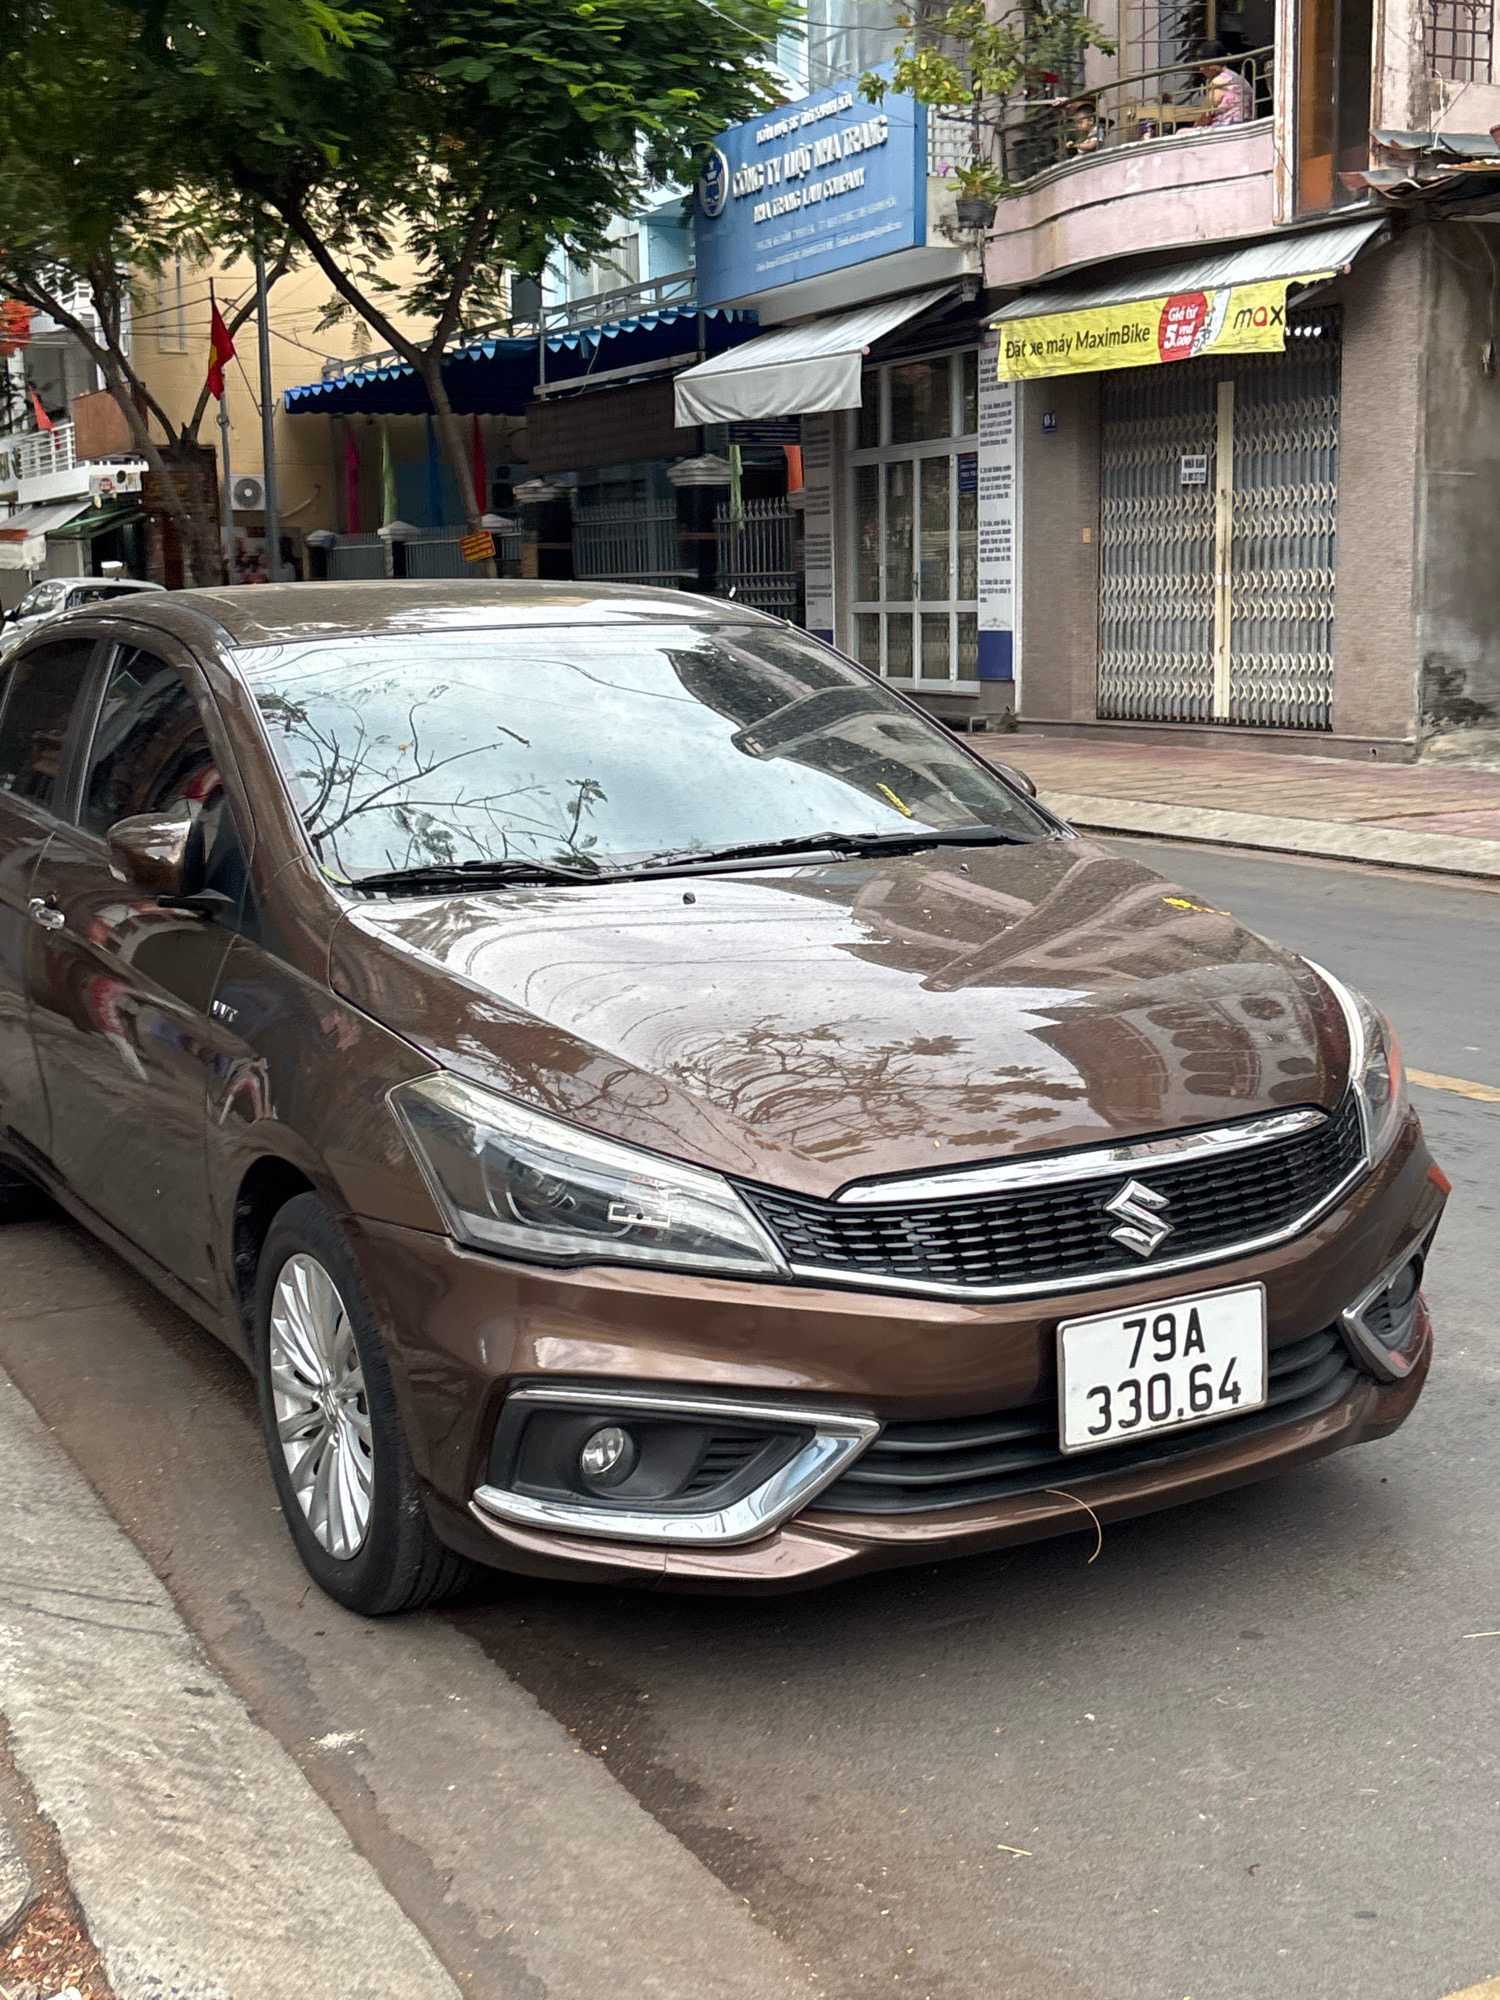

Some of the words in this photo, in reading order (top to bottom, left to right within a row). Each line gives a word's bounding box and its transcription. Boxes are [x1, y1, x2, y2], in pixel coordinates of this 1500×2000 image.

[732, 163, 765, 198] CÔNG
[765, 156, 782, 186] TY
[783, 143, 812, 180] LUẬT
[813, 134, 842, 168] NHA
[842, 114, 889, 157] TRANG
[771, 190, 801, 215] TRANG
[802, 182, 822, 206] LAW
[823, 167, 866, 199] COMPANY
[1168, 305, 1185, 321] Giá
[1186, 304, 1199, 320] từ
[1233, 305, 1284, 329] max
[1029, 341, 1044, 356] xe
[1046, 333, 1073, 356] máy
[1075, 323, 1151, 351] MaximBike
[1122, 1307, 1206, 1369] 79A
[1086, 1356, 1242, 1436] 330.64
